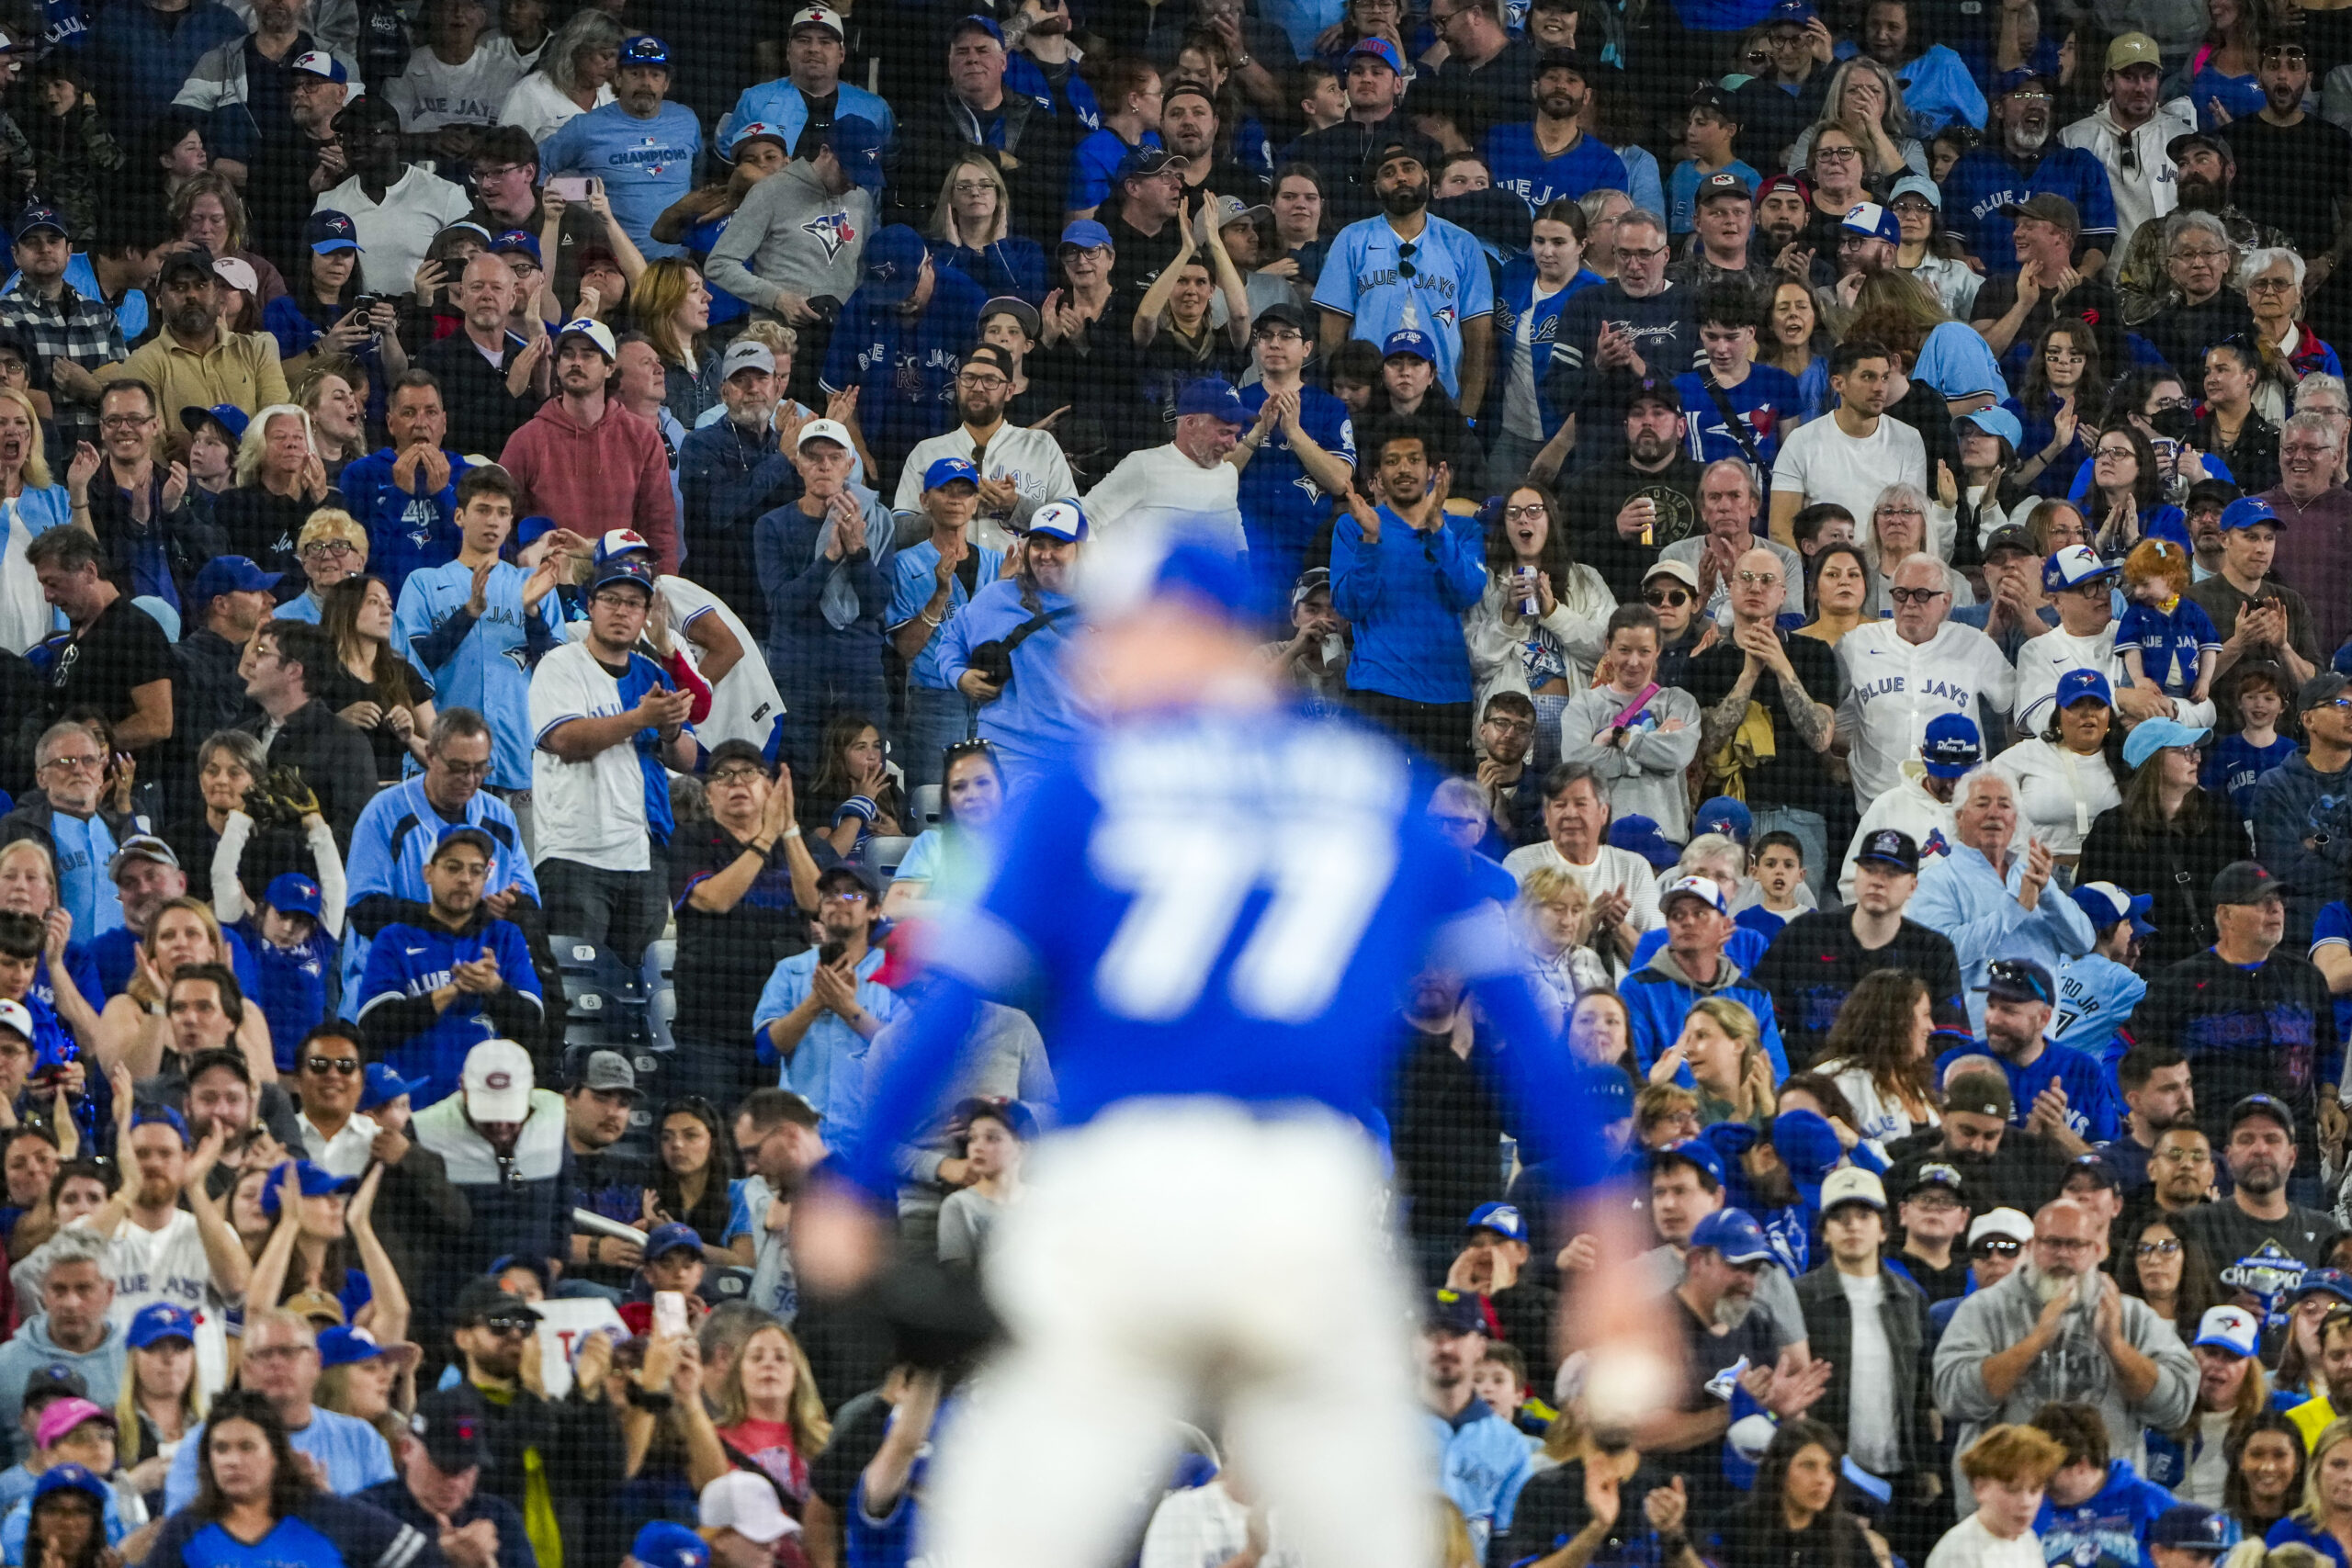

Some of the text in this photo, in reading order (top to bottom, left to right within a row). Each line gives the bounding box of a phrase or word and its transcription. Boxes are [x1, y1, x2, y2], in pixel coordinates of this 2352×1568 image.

[608, 148, 687, 165] CHAMPIONS
[1971, 189, 2015, 220] BLUE
[1357, 269, 1456, 299] BLUE JAYS
[1855, 676, 1969, 709] BLUE JAYS
